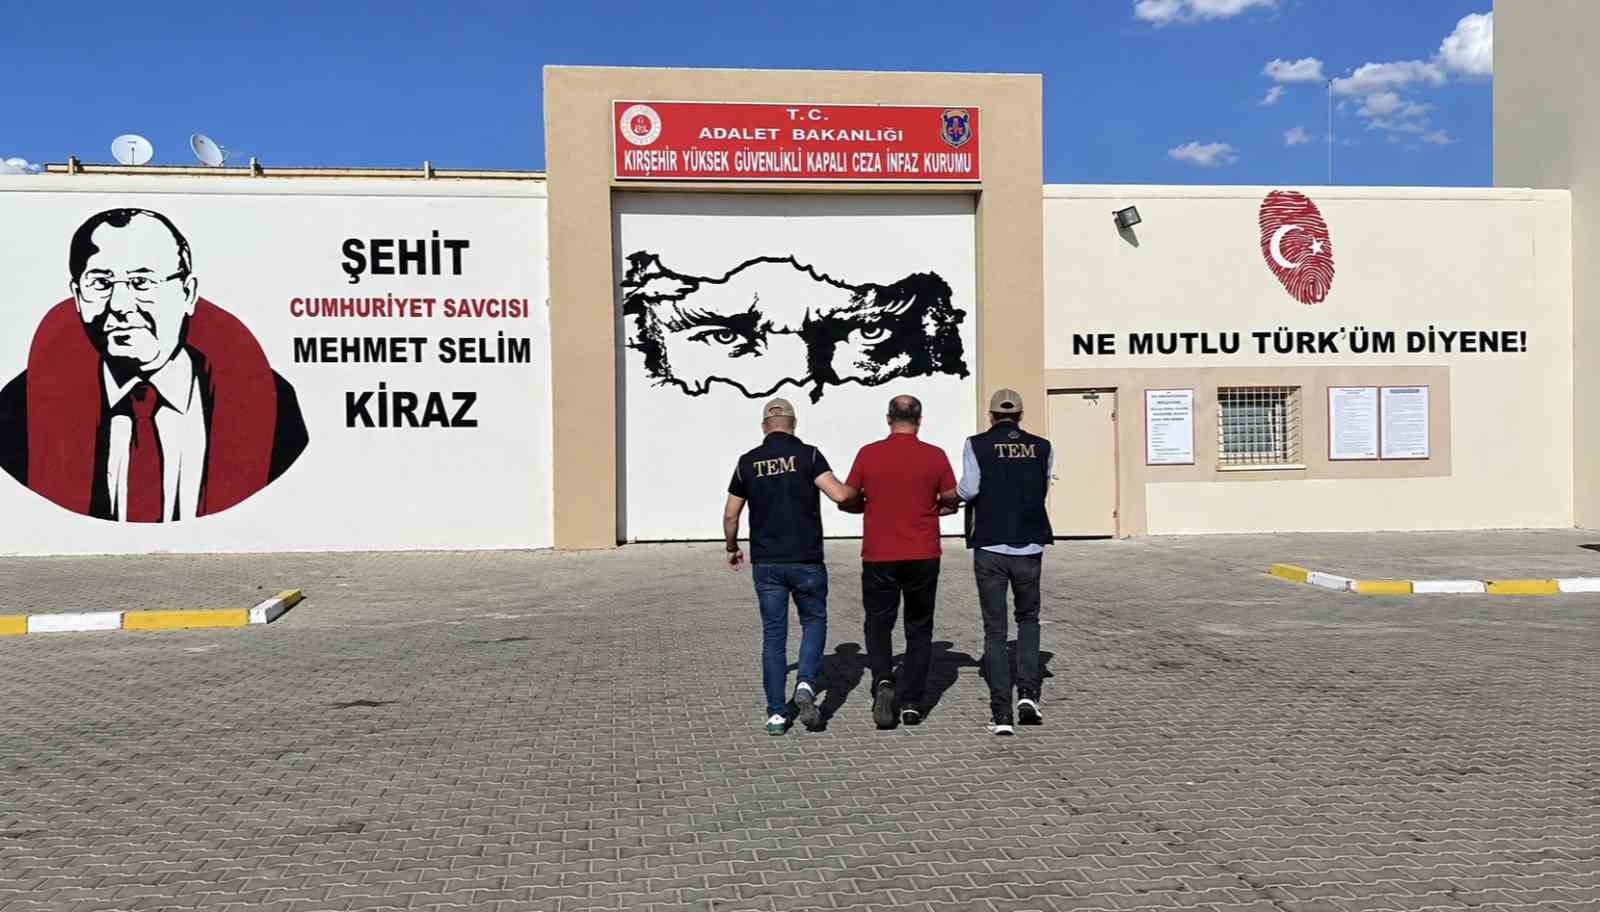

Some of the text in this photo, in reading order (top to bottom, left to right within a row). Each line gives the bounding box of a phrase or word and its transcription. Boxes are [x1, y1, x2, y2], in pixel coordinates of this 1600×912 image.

[698, 127, 904, 142] ADALET BAKANLIĞI
[624, 145, 972, 176] KIRŞEHİR YÜKSEK GÜVENLİKLİ KAPALI CEZA İNFAZ KURUMU
[341, 229, 470, 285] ŞEHİT
[290, 292, 529, 318] CUMHURİYET SAVCISI
[293, 330, 531, 364] MEHMET SELİM
[1072, 333, 1117, 355] NE
[1128, 332, 1241, 355] MUTLU
[1406, 325, 1528, 353] DİYENE!
[345, 381, 478, 428] KİRAZ
[994, 443, 1036, 459] TEM
[752, 455, 797, 479] TEM
